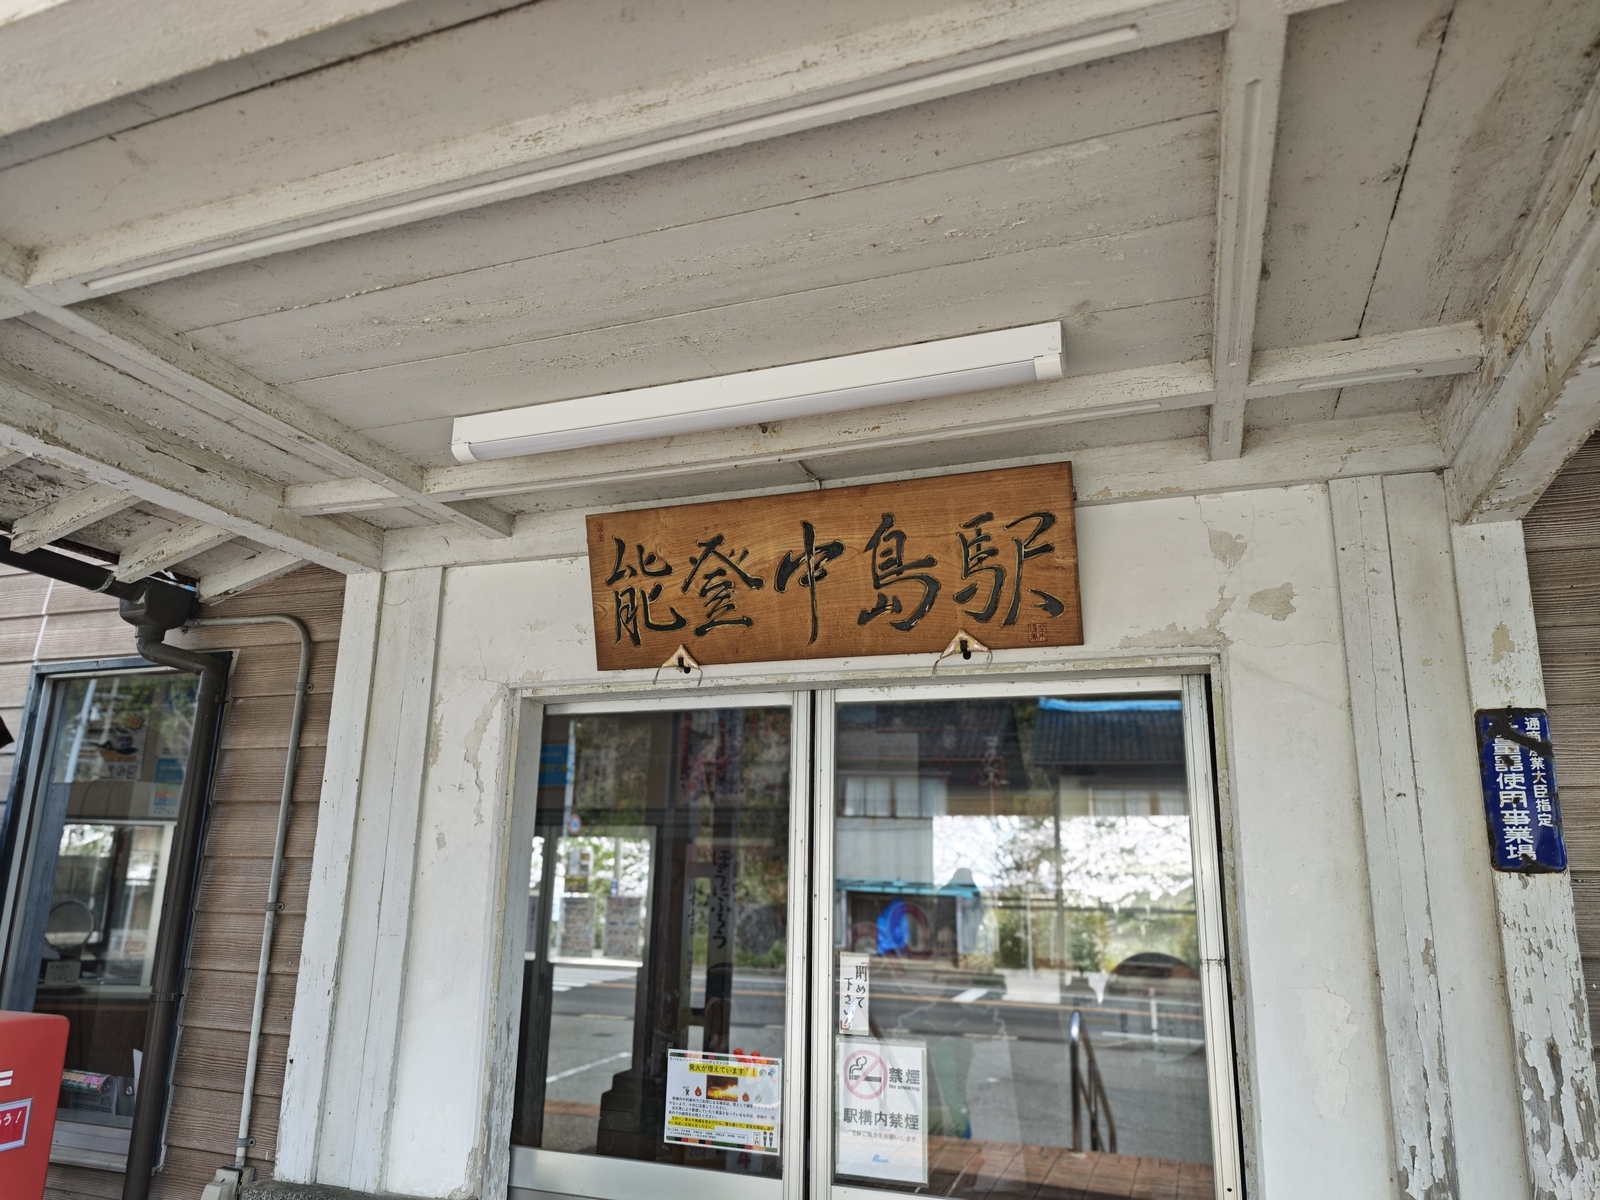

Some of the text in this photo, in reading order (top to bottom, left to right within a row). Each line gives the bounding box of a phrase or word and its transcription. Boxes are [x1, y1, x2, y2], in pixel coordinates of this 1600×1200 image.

[606, 511, 1065, 646] 能登中島駅
[1490, 716, 1537, 861] 量器使用事業場
[889, 1067, 920, 1085] 禁煙
[0, 1110, 22, 1126] う！
[843, 1107, 920, 1131] 駅構内禁煙
